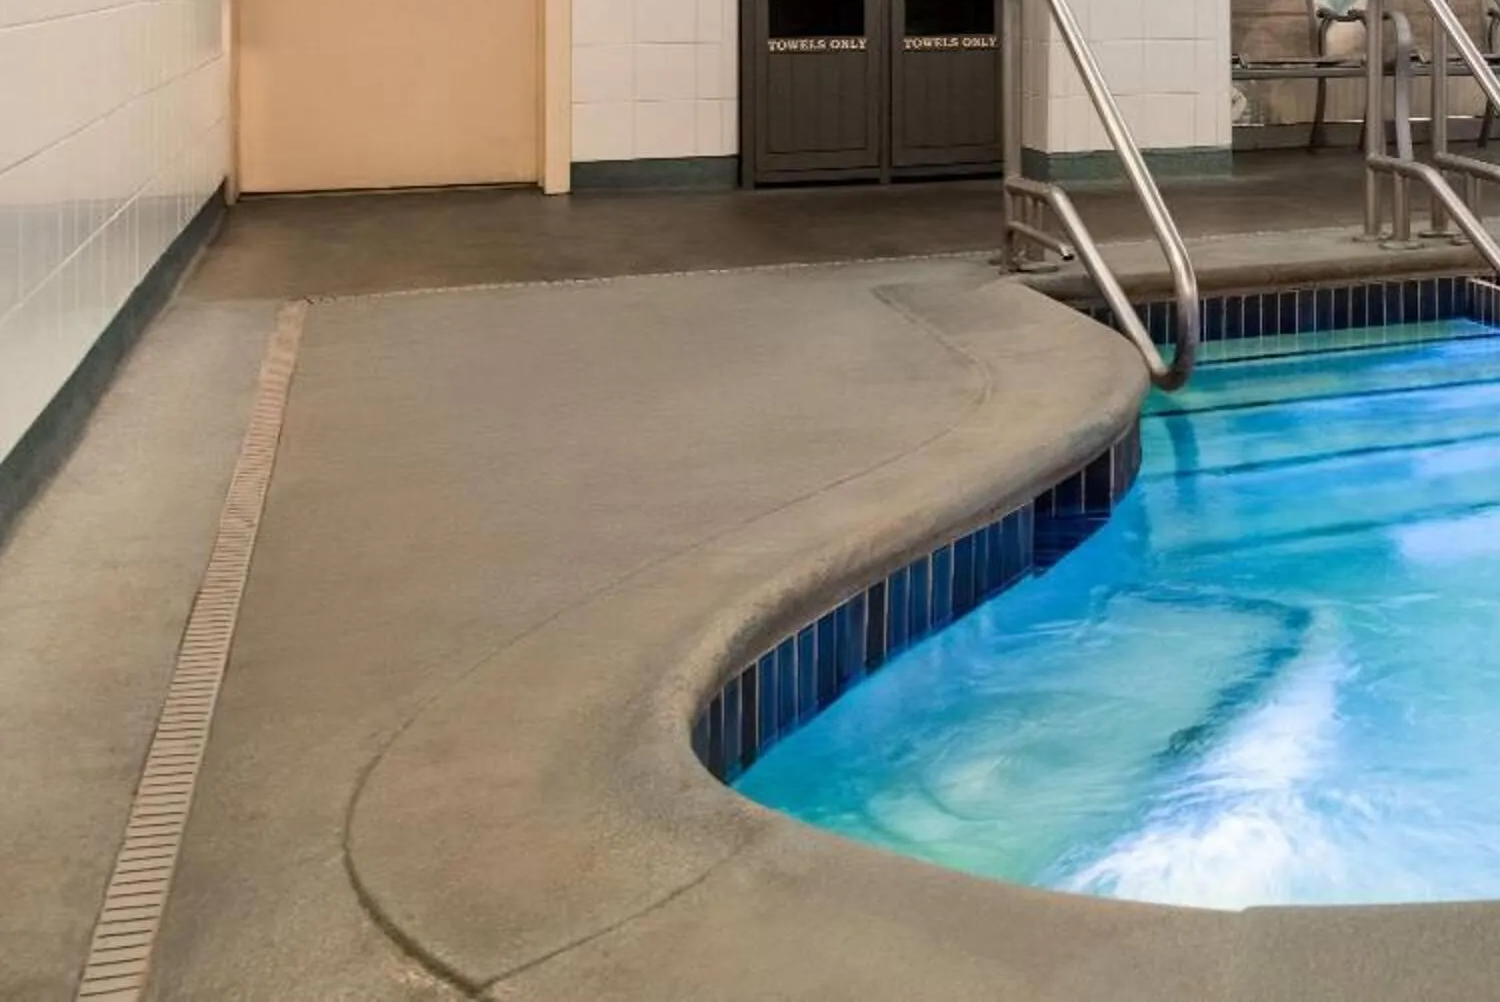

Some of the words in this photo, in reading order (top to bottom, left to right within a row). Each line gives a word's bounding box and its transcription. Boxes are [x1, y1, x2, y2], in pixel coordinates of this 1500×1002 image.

[767, 39, 827, 52] TOWELS
[829, 38, 868, 50] ONLY
[903, 37, 960, 50] TOWELS
[961, 37, 998, 48] ONLY
